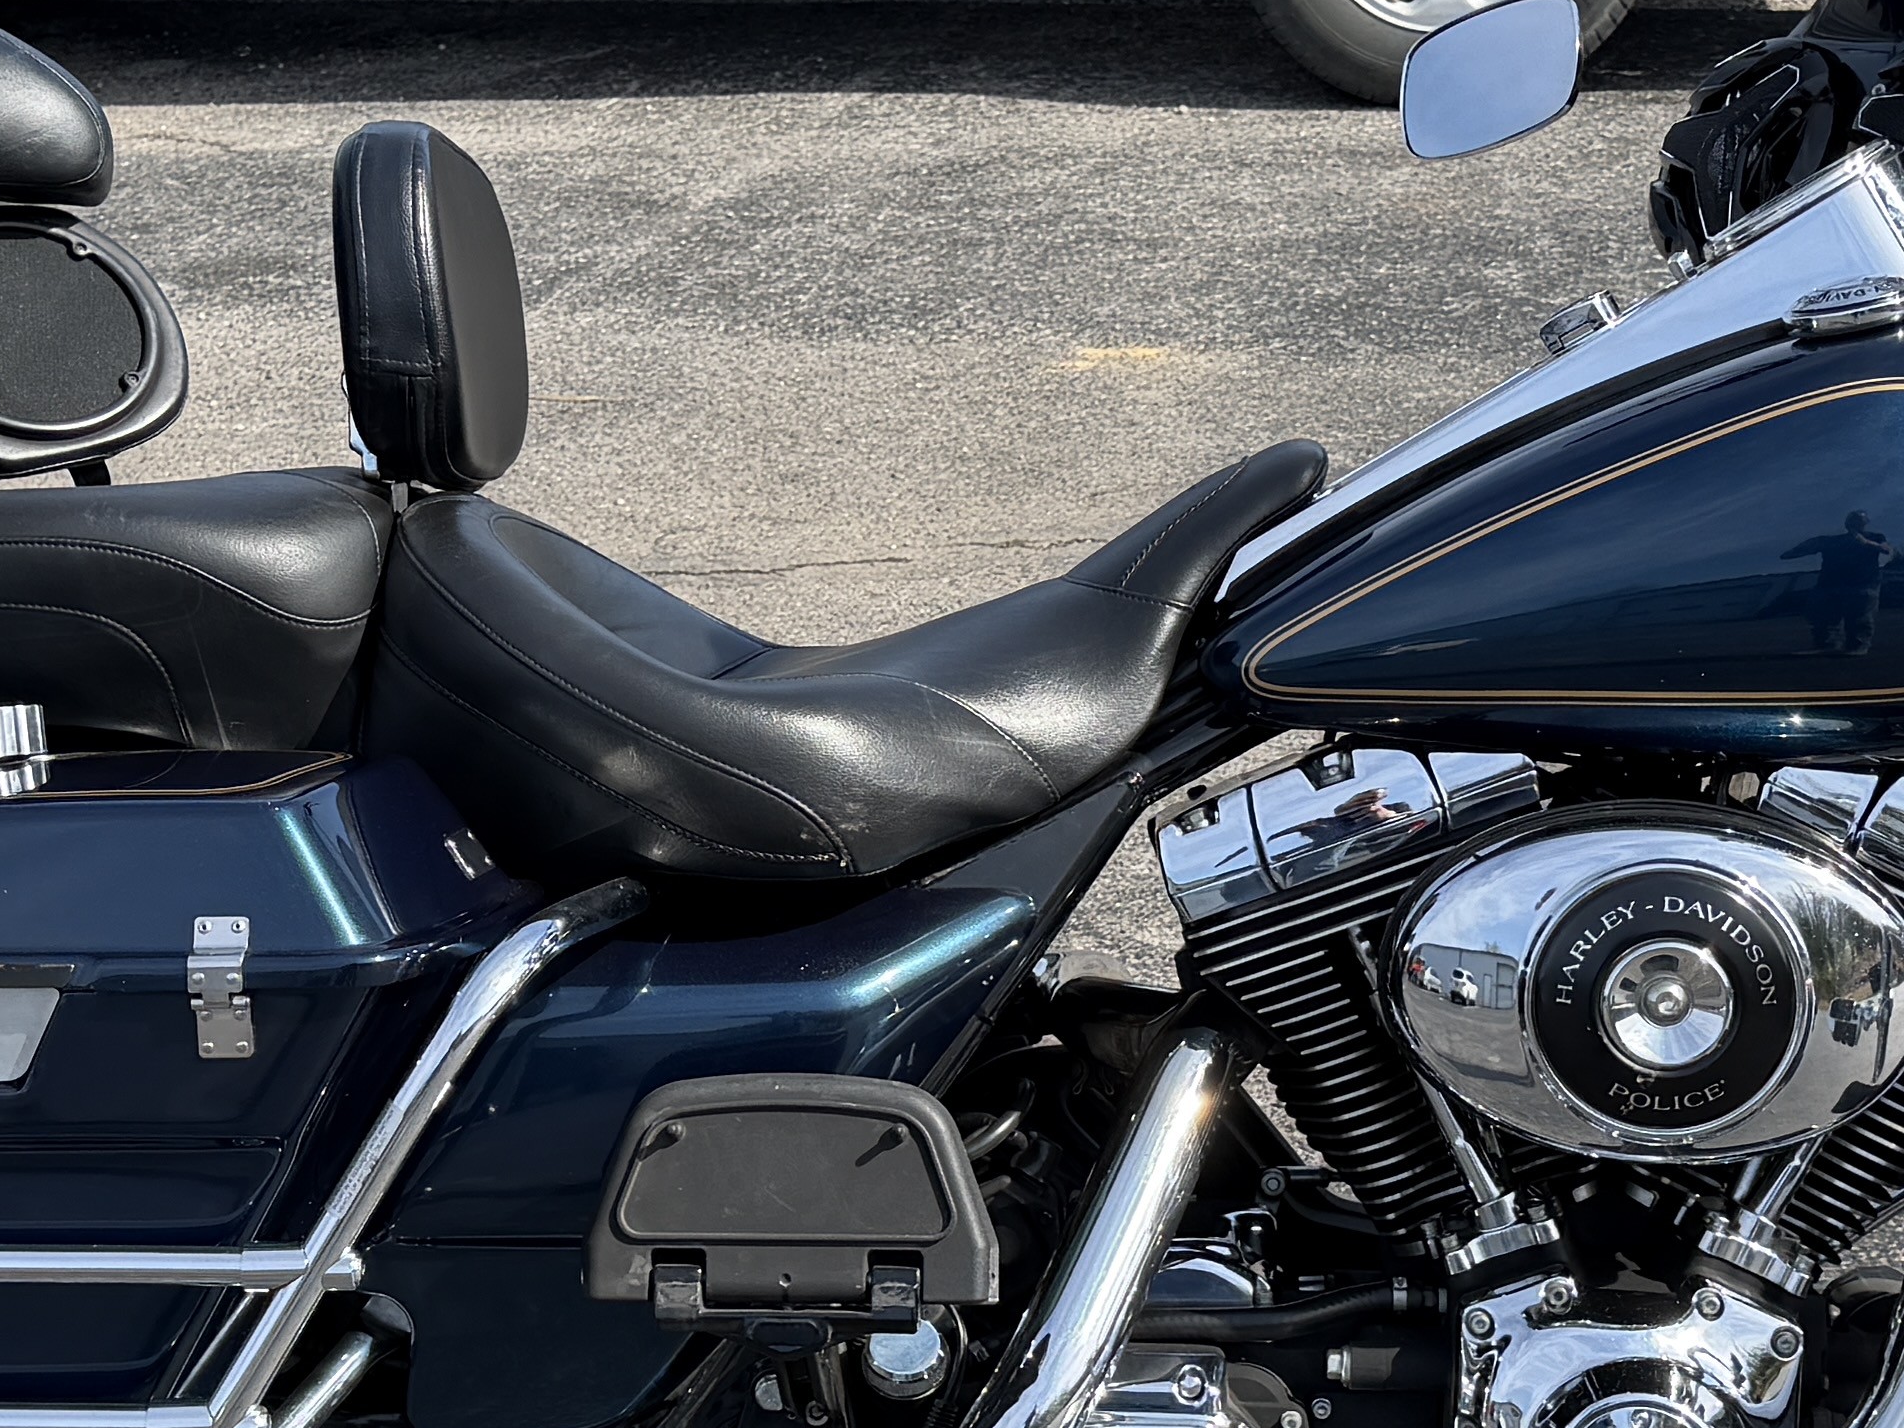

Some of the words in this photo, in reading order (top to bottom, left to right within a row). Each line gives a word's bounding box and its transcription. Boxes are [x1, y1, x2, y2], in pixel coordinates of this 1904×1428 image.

[1555, 900, 1636, 1005] HARLEY
[1662, 896, 1778, 1006] DAVIDSON
[1608, 1080, 1726, 1111] POLICE
